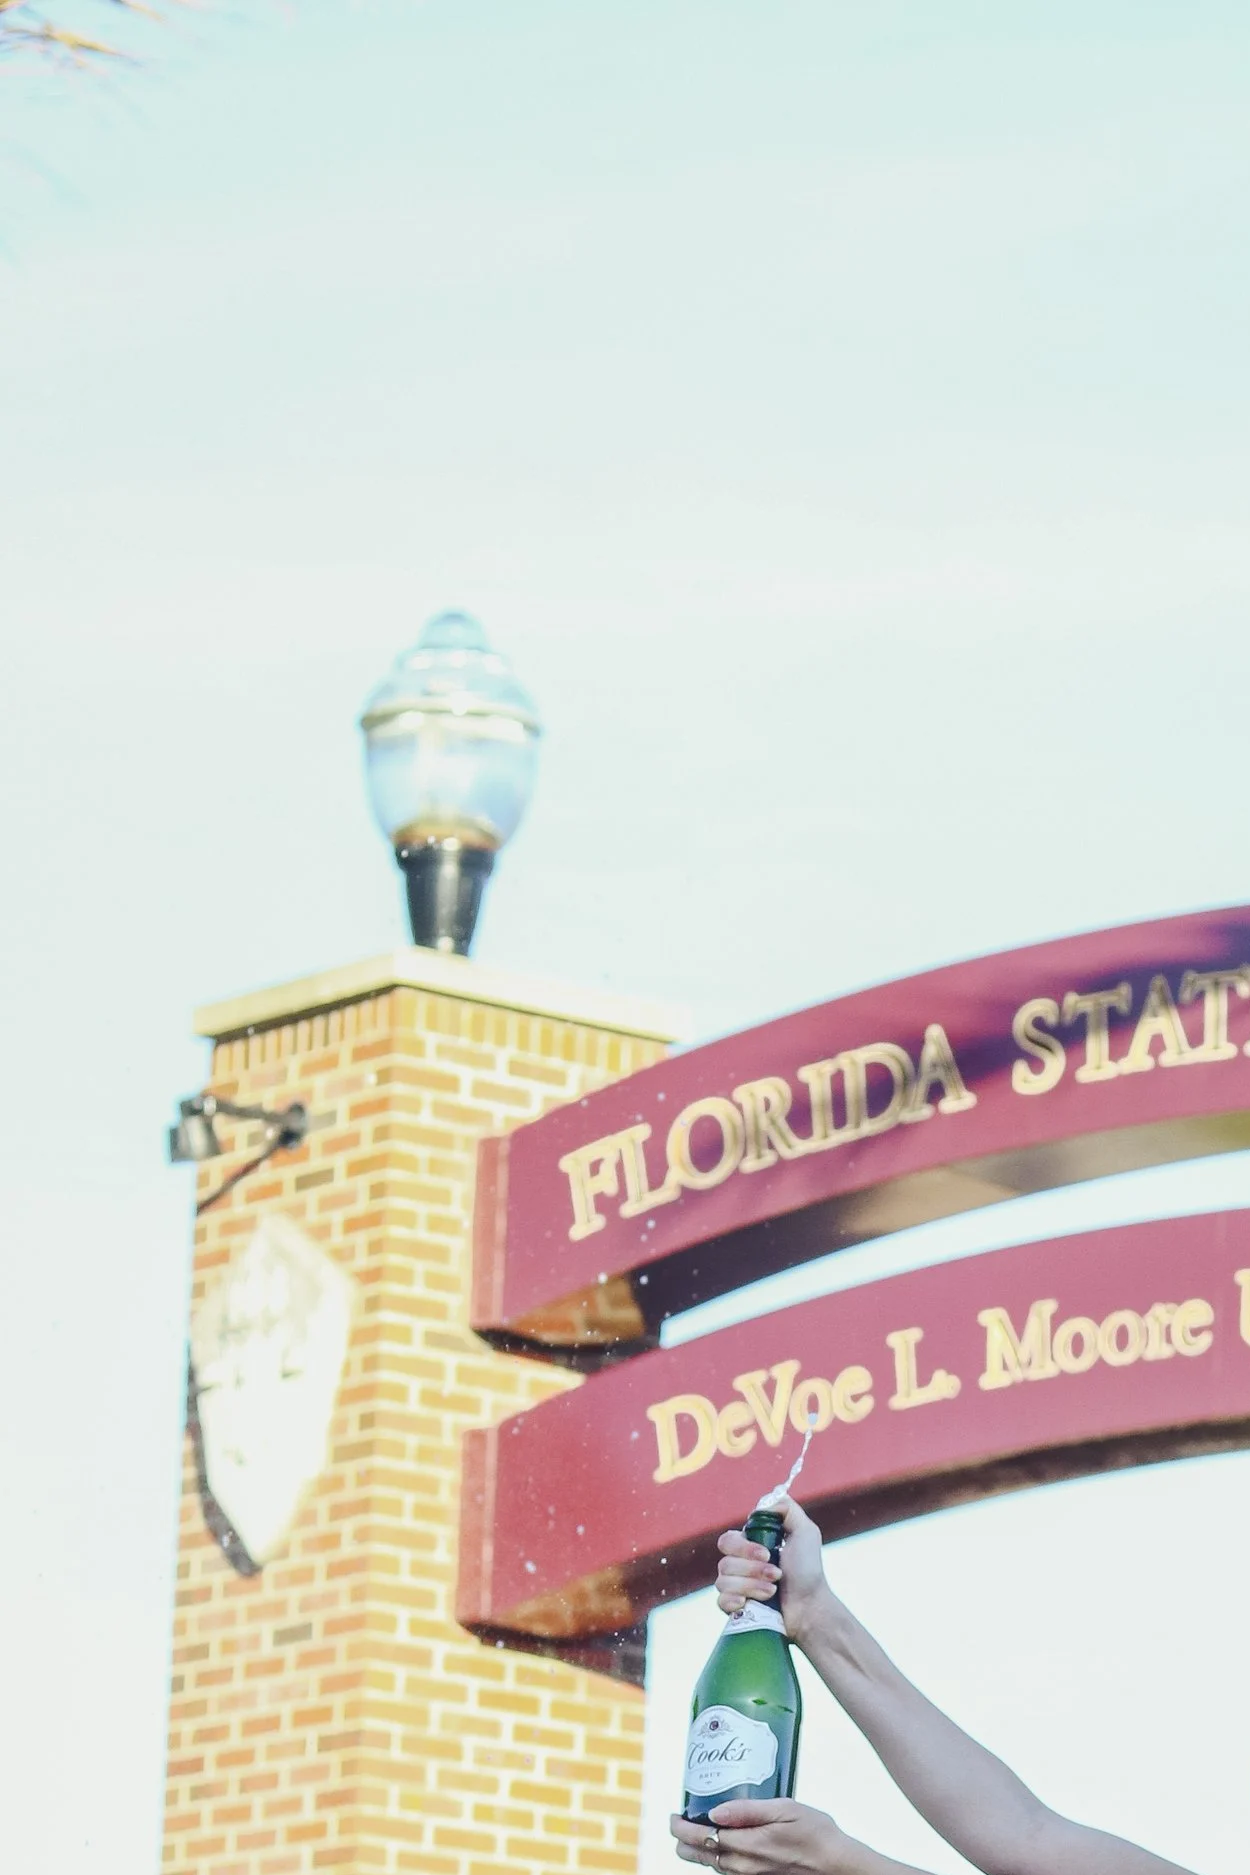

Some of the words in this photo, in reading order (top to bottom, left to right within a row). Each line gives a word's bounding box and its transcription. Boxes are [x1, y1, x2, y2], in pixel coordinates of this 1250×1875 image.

[559, 1024, 977, 1242] FLORIDA
[646, 1359, 875, 1484] DeVoe
[885, 1327, 961, 1411] L.
[976, 1298, 1215, 1391] Moore
[688, 1736, 752, 1770] Cook's
